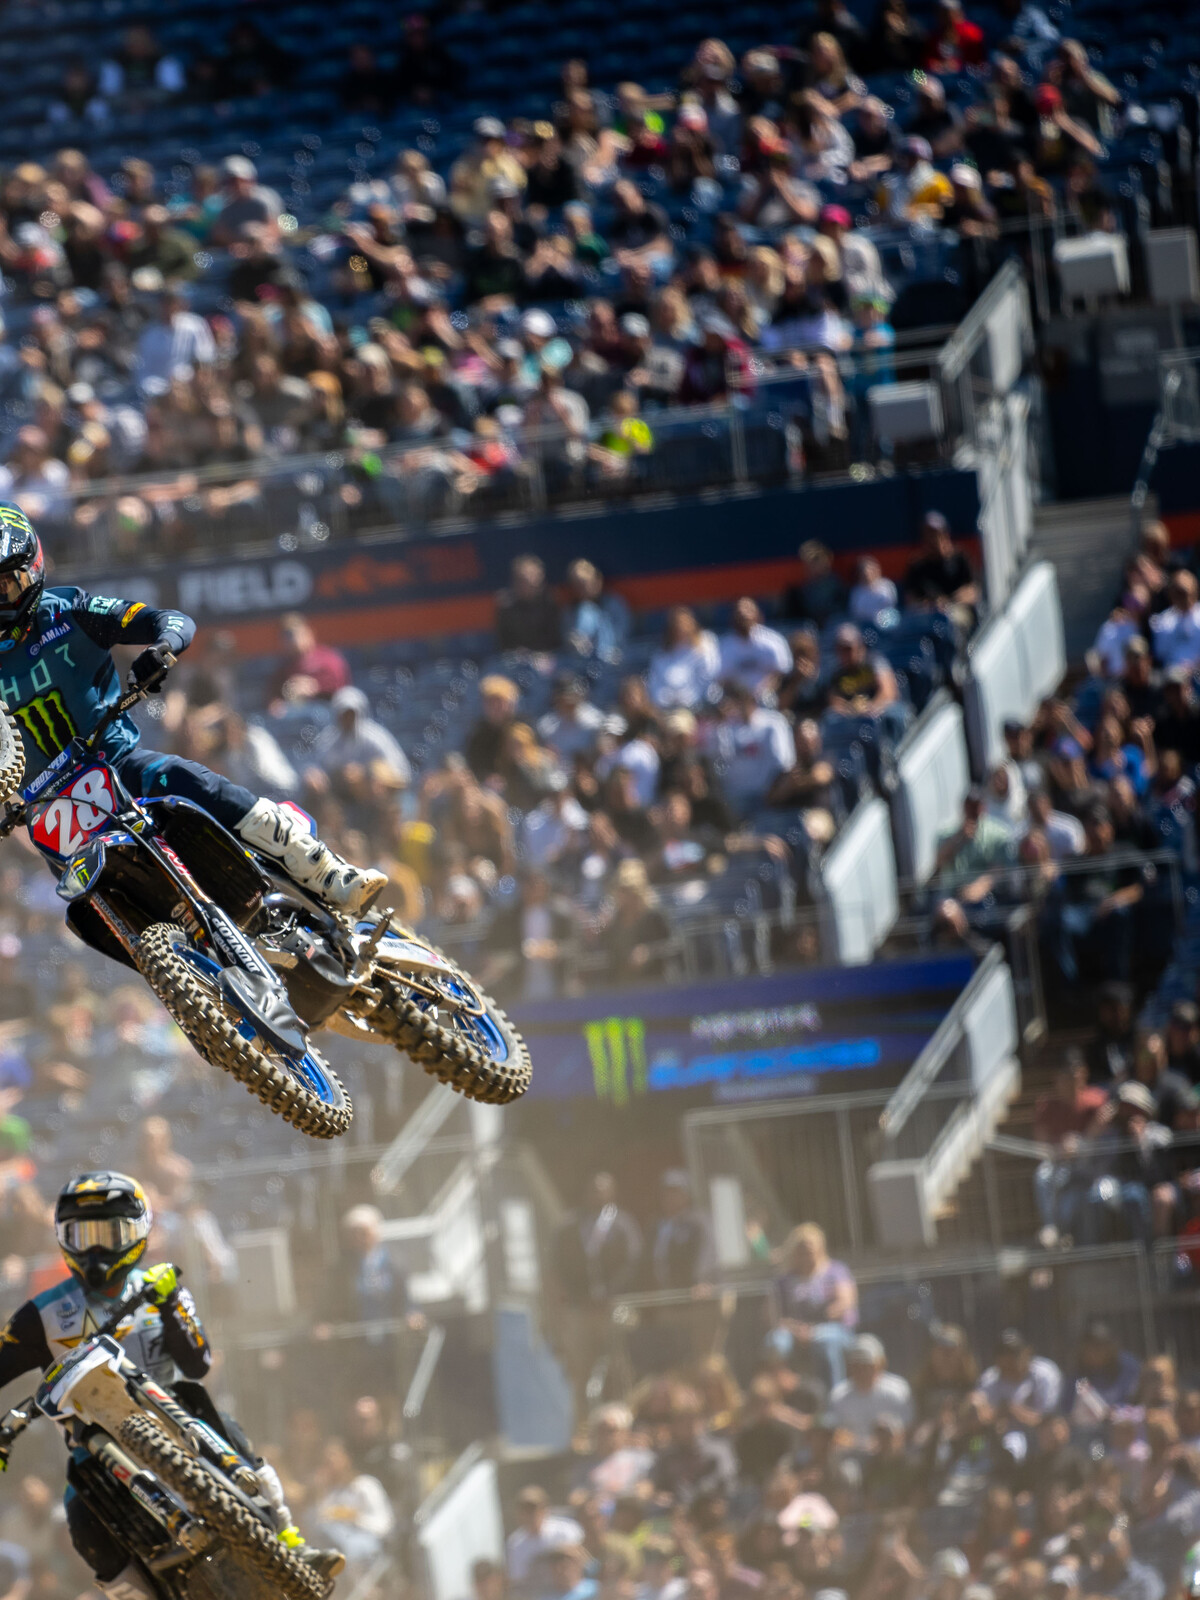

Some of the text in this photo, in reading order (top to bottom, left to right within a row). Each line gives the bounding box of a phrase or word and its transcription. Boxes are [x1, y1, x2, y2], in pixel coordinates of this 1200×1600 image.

[176, 560, 314, 615] FIELD
[44, 769, 114, 858] 28
[211, 917, 262, 974] DUNLOP
